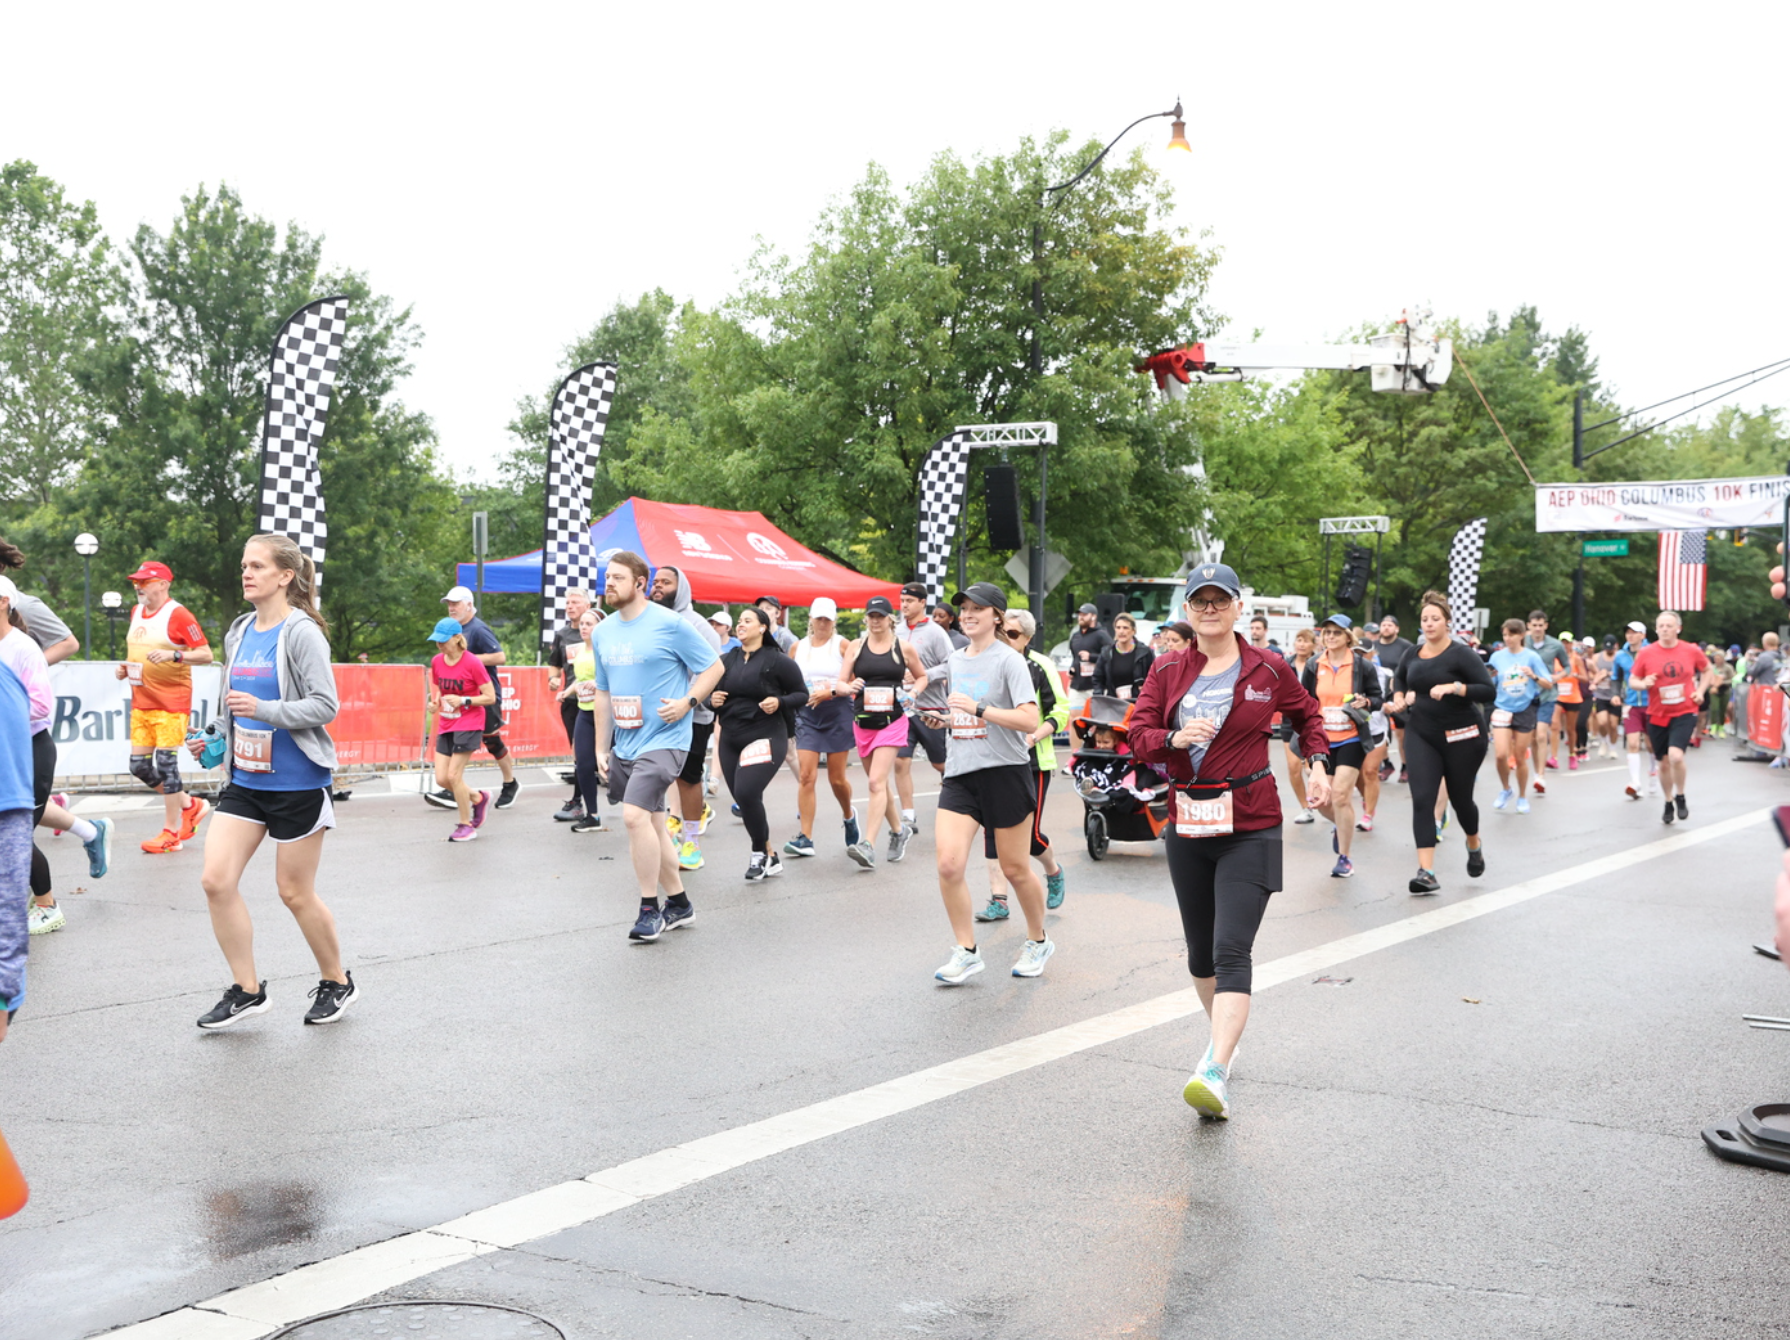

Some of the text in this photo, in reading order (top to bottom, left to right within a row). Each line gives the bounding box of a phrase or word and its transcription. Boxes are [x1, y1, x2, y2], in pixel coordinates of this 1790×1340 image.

[1549, 490, 1576, 507] AEP
[1620, 486, 1706, 506] COLUMBUS
[1714, 484, 1744, 502] 10K
[501, 686, 515, 699] EP
[869, 694, 888, 704] 302
[501, 698, 521, 711] HIO
[613, 705, 637, 718] 1400
[952, 712, 980, 726] 2821
[1181, 803, 1227, 822] 1980
